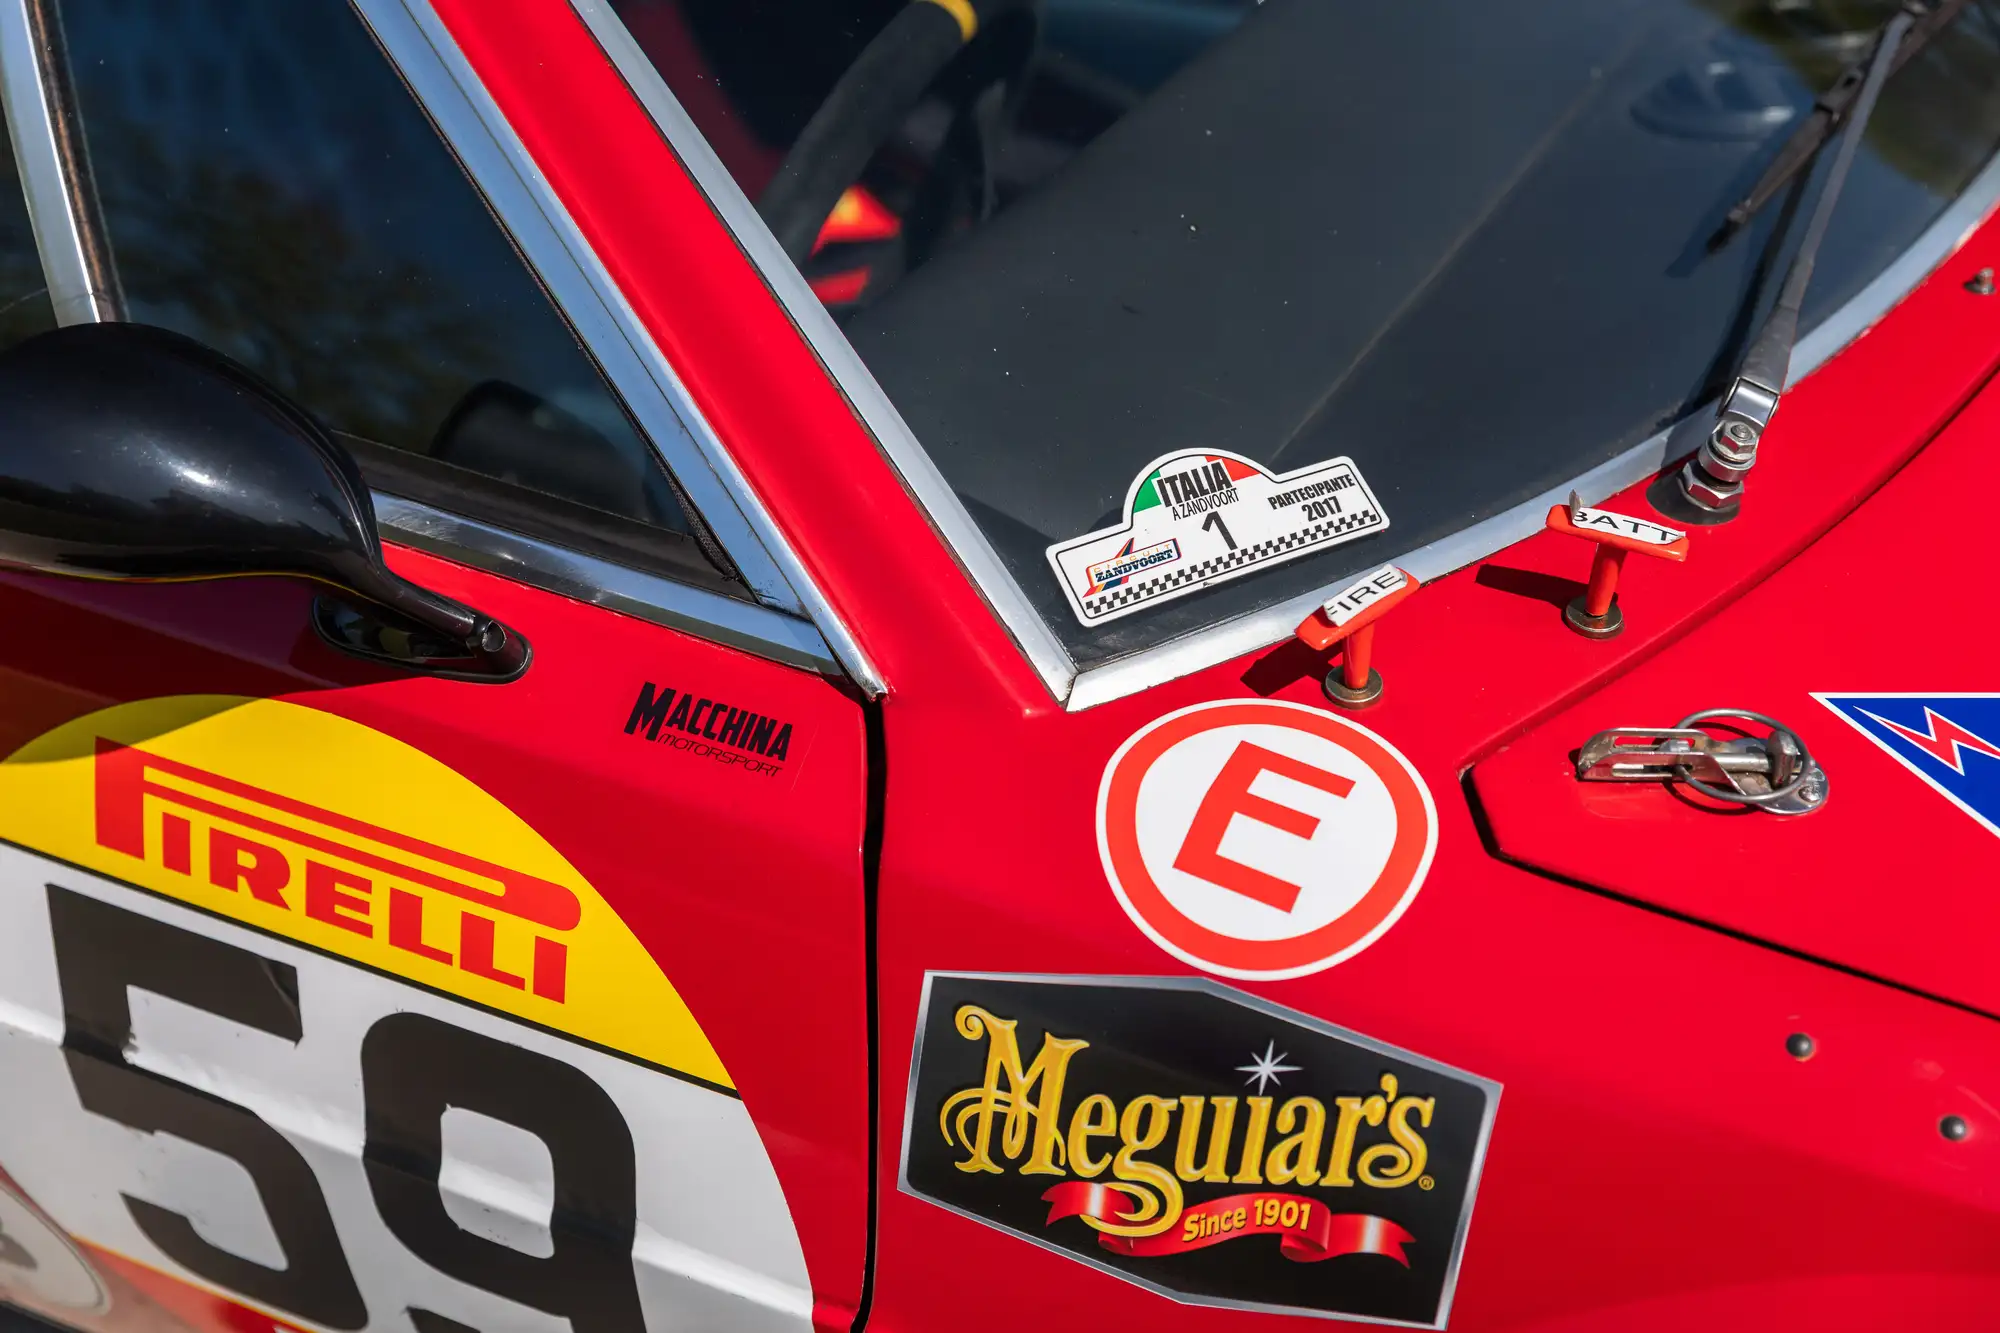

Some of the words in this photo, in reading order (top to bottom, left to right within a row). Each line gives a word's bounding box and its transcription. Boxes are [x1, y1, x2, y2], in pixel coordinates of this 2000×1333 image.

[1156, 461, 1233, 508] ITALIA
[1171, 506, 1182, 522] A
[1178, 487, 1240, 519] ZANDVOORT
[1266, 473, 1356, 511] PARTECIPANTE
[1201, 510, 1239, 551] 1
[1301, 495, 1342, 522] 2017
[1093, 543, 1171, 574] CIRCUIT
[1094, 548, 1174, 583] ZANDVOORT
[623, 681, 794, 762] MACCHINA
[657, 732, 784, 778] MOTORSPORT
[1171, 739, 1357, 915] E
[94, 735, 583, 1005] PIRELLI
[46, 881, 648, 1333] 59
[1181, 1206, 1248, 1243] Since
[1253, 1198, 1313, 1231] 1901
